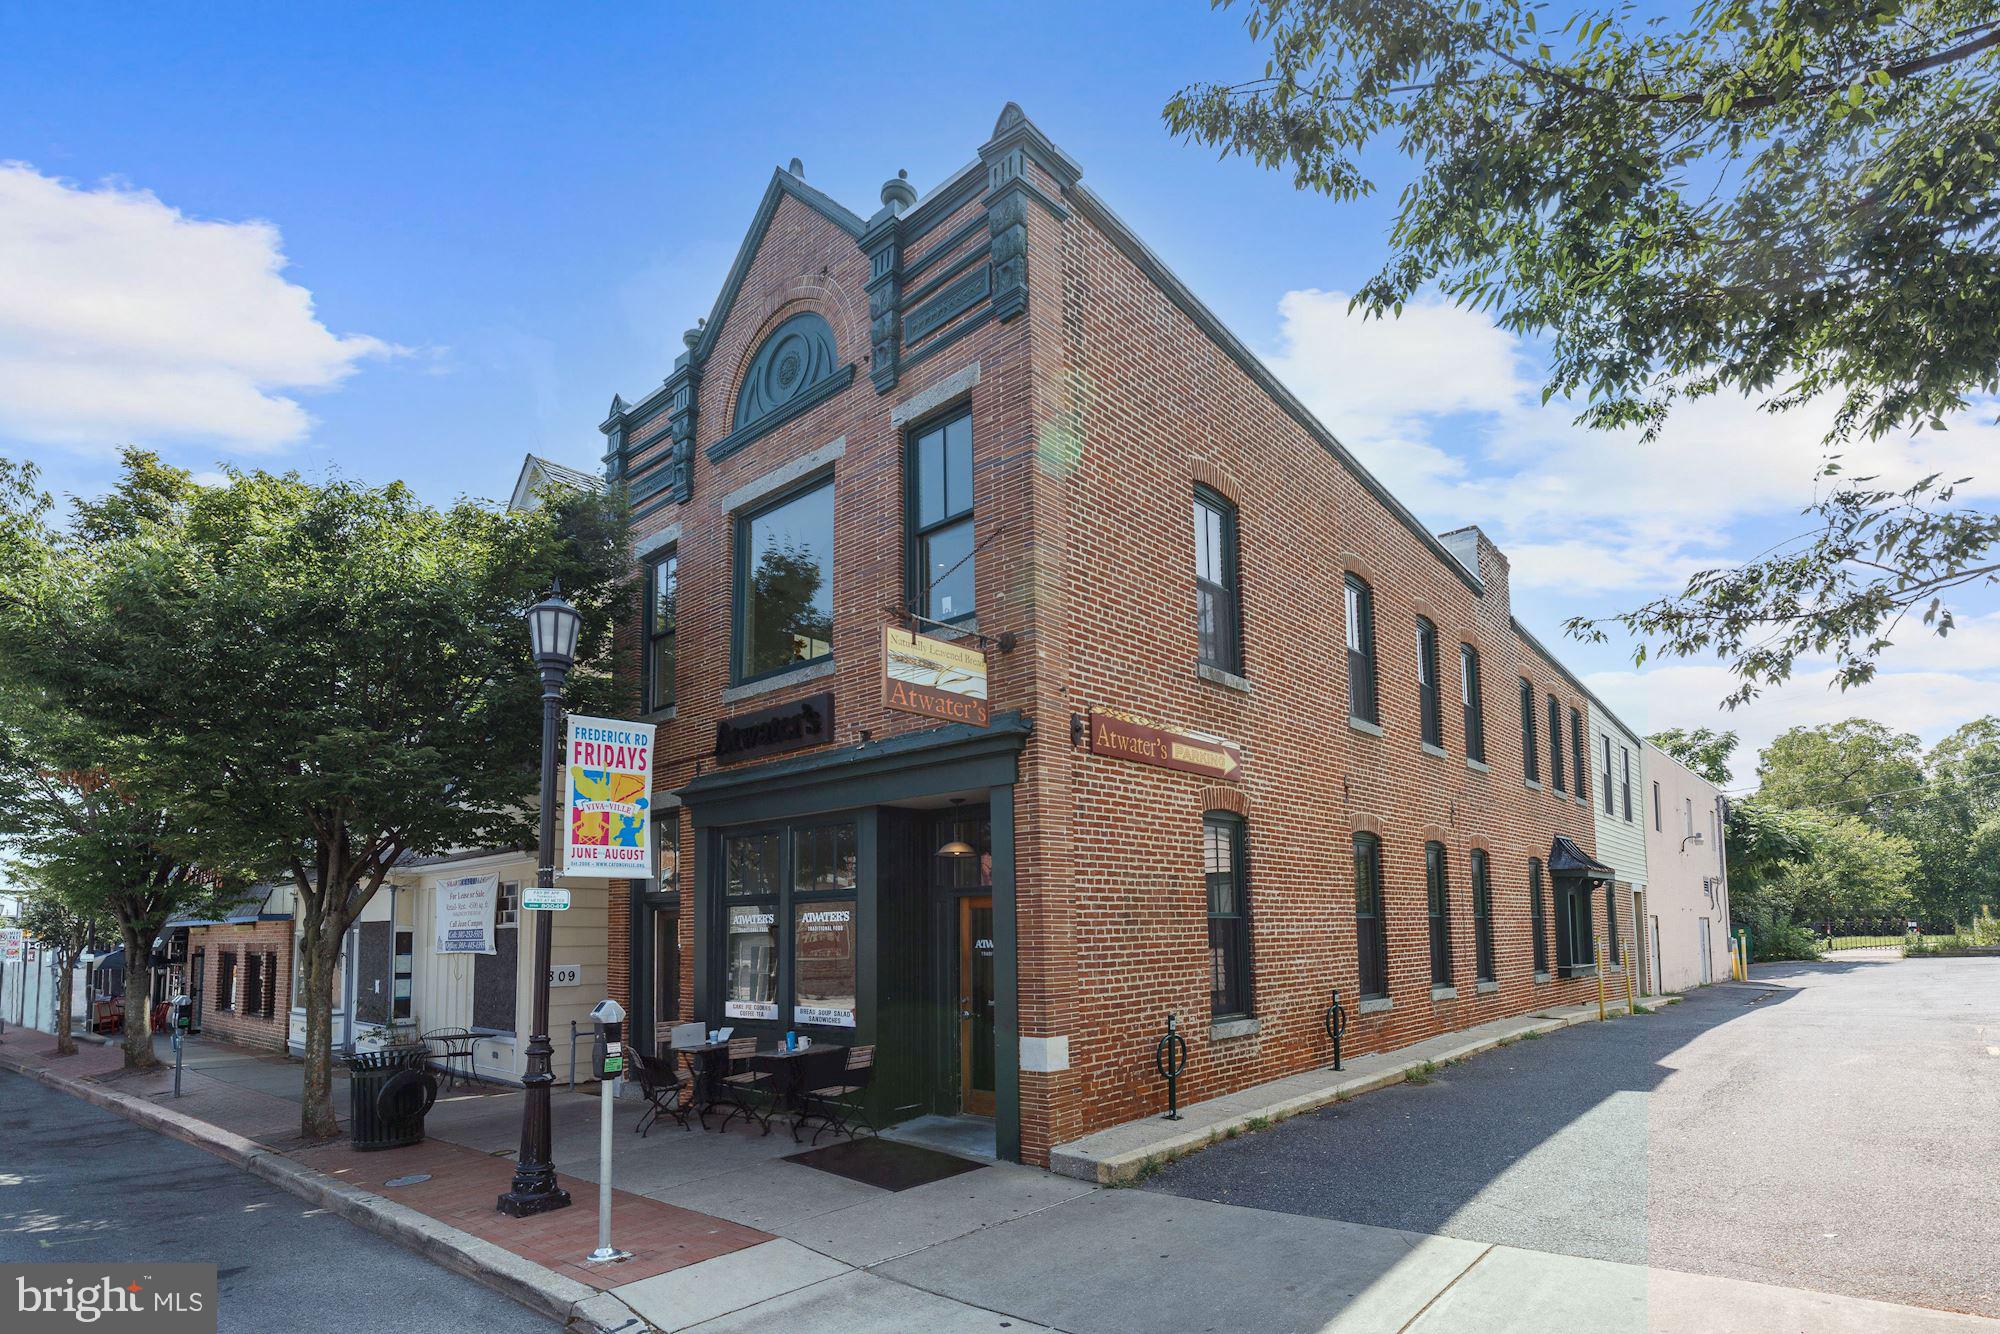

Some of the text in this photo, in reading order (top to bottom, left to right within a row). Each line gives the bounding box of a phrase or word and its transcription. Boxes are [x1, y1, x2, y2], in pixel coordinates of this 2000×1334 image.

[890, 634, 926, 655] Naturally
[929, 644, 963, 662] Leavened
[890, 681, 986, 721] Atwater's
[575, 727, 648, 746] FREDERICK RD
[1096, 722, 1226, 768] Atwater's PARKING
[574, 741, 647, 771] FRIDAYS
[609, 803, 632, 814] VILLE
[571, 847, 598, 859] JUNE
[604, 848, 645, 860] AUGUST
[733, 914, 775, 924] ATWATER'S
[802, 911, 850, 923] ATWATER'S
[808, 1016, 841, 1024] SANDWICHES
